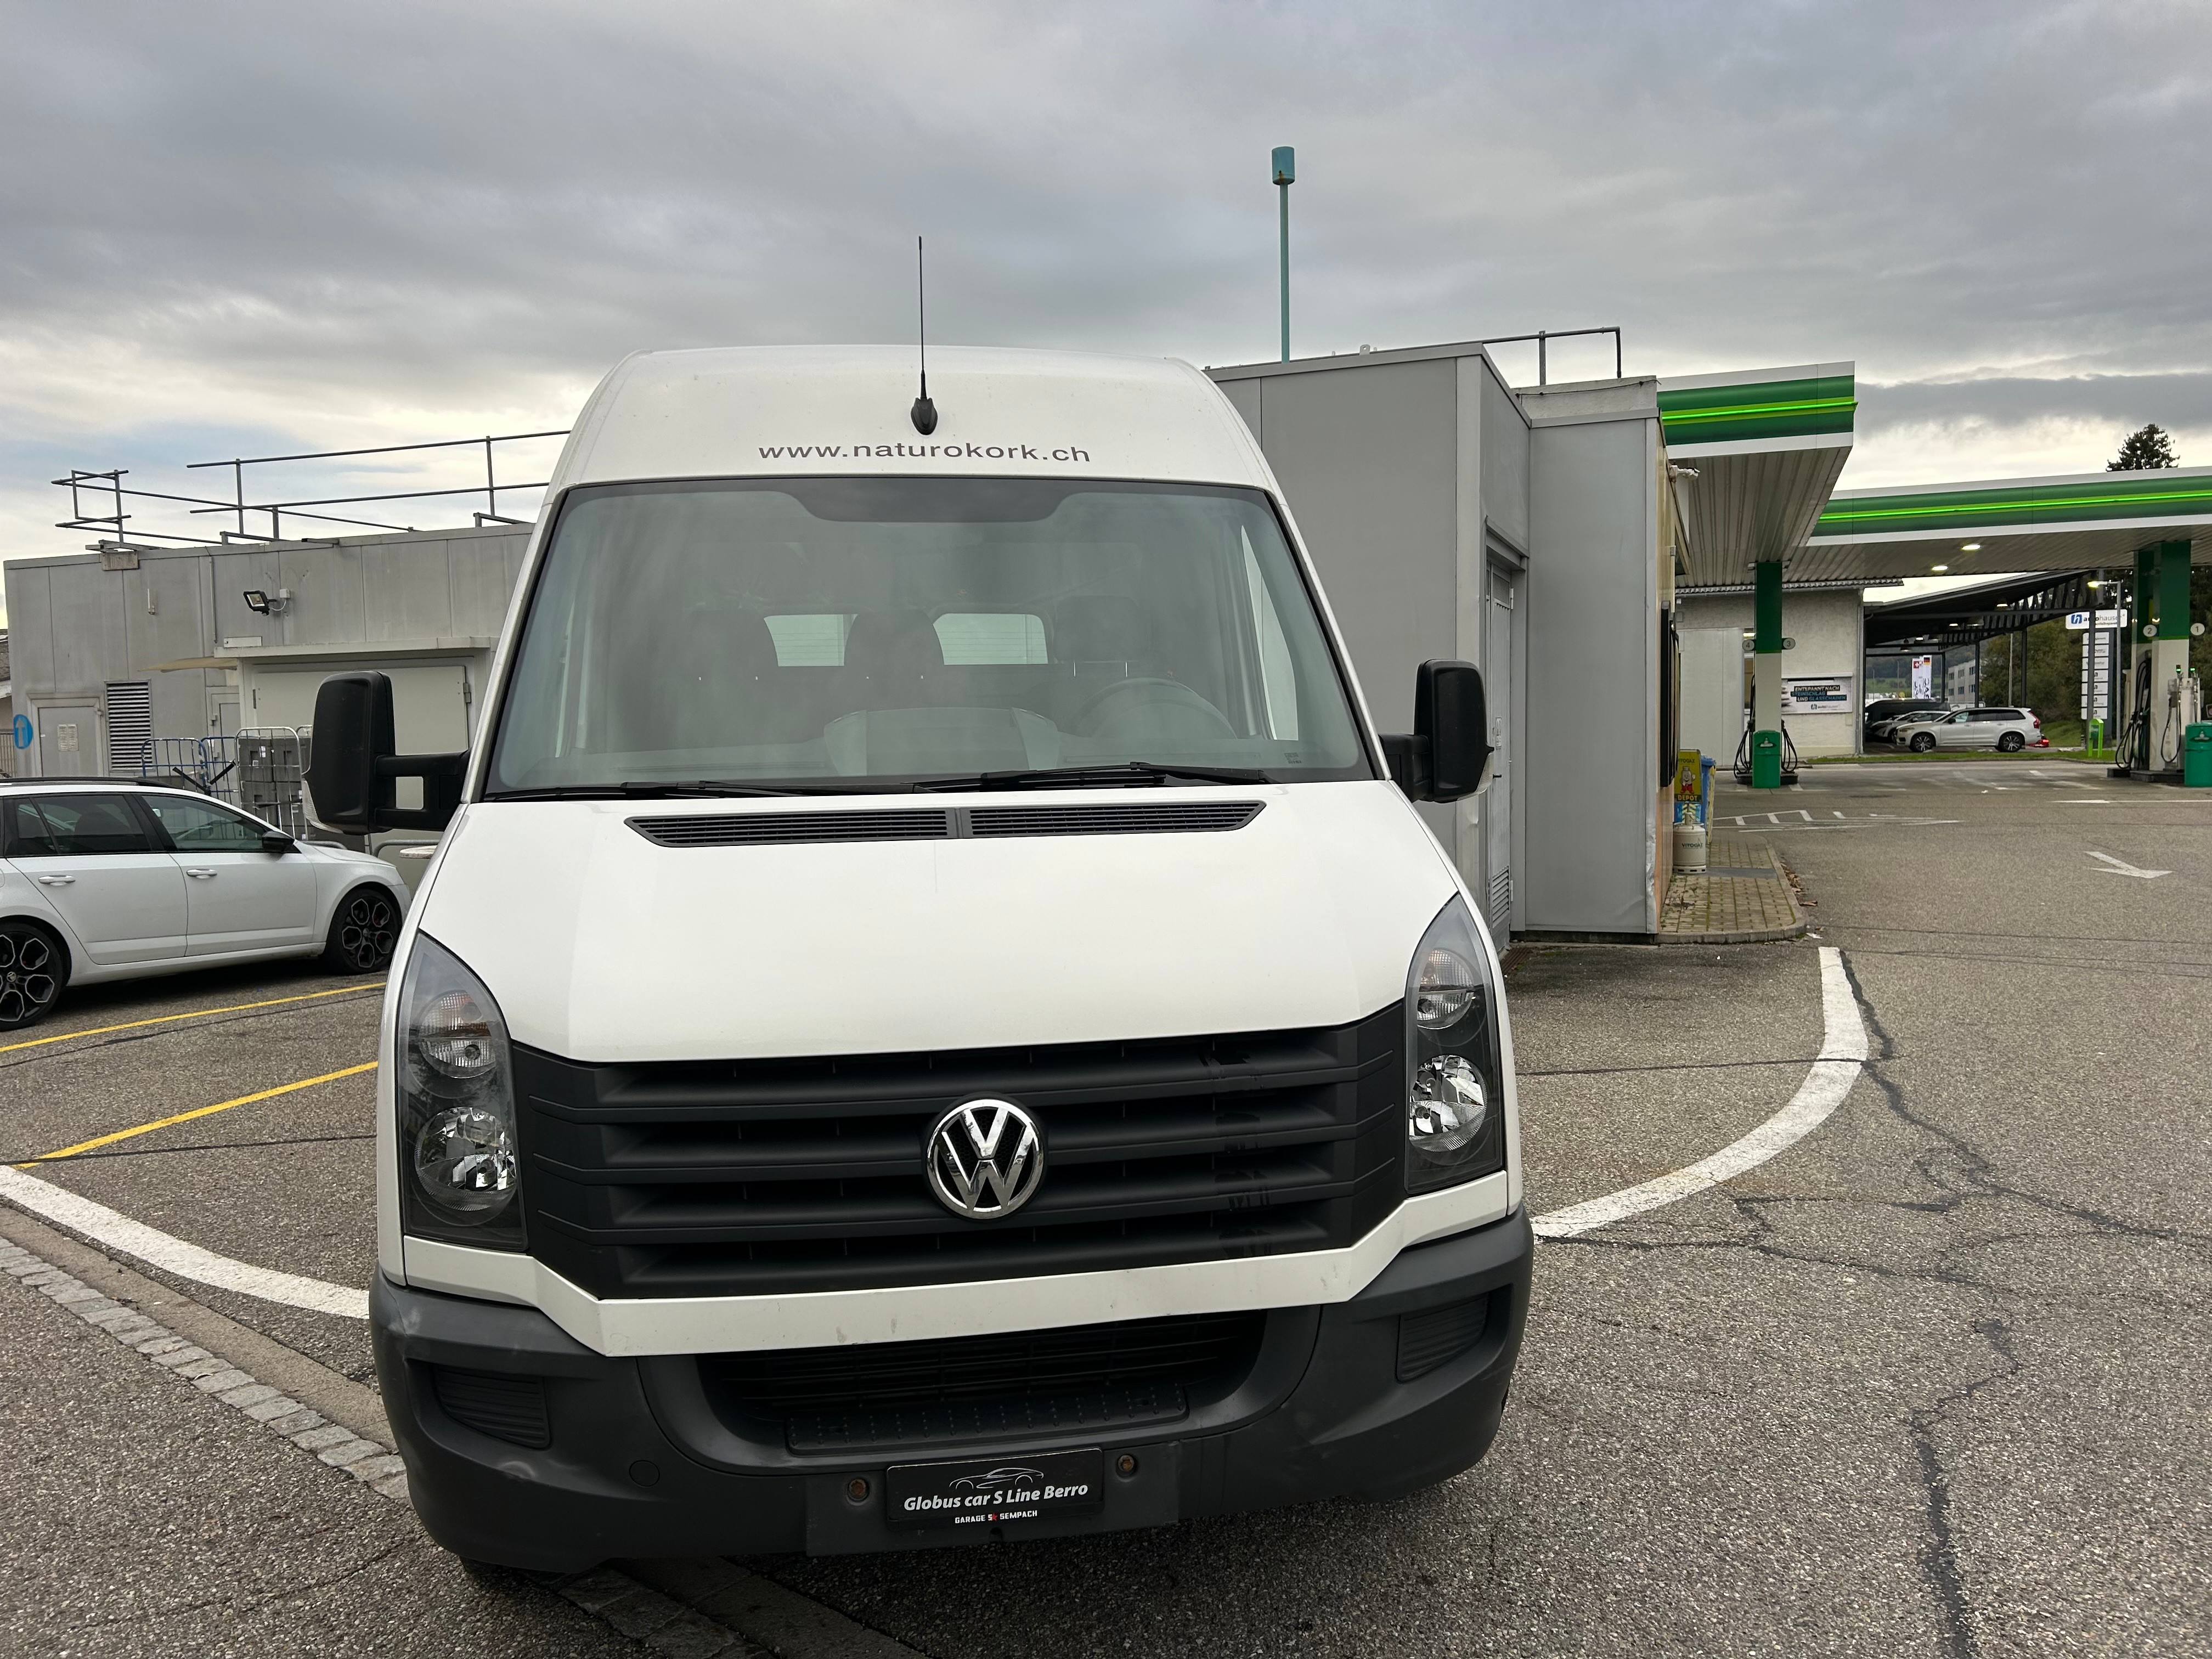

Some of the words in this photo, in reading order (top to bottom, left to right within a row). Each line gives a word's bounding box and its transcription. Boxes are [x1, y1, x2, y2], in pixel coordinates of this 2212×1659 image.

[758, 443, 1090, 462] www.naturokork.ch
[904, 1495, 961, 1511] Globus
[964, 1493, 991, 1507] car
[993, 1490, 1003, 1505] S
[1006, 1488, 1040, 1503] Line
[1043, 1484, 1088, 1499] Berro
[955, 1514, 986, 1523] GARAGE
[1000, 1510, 1037, 1520] SEMPACH
